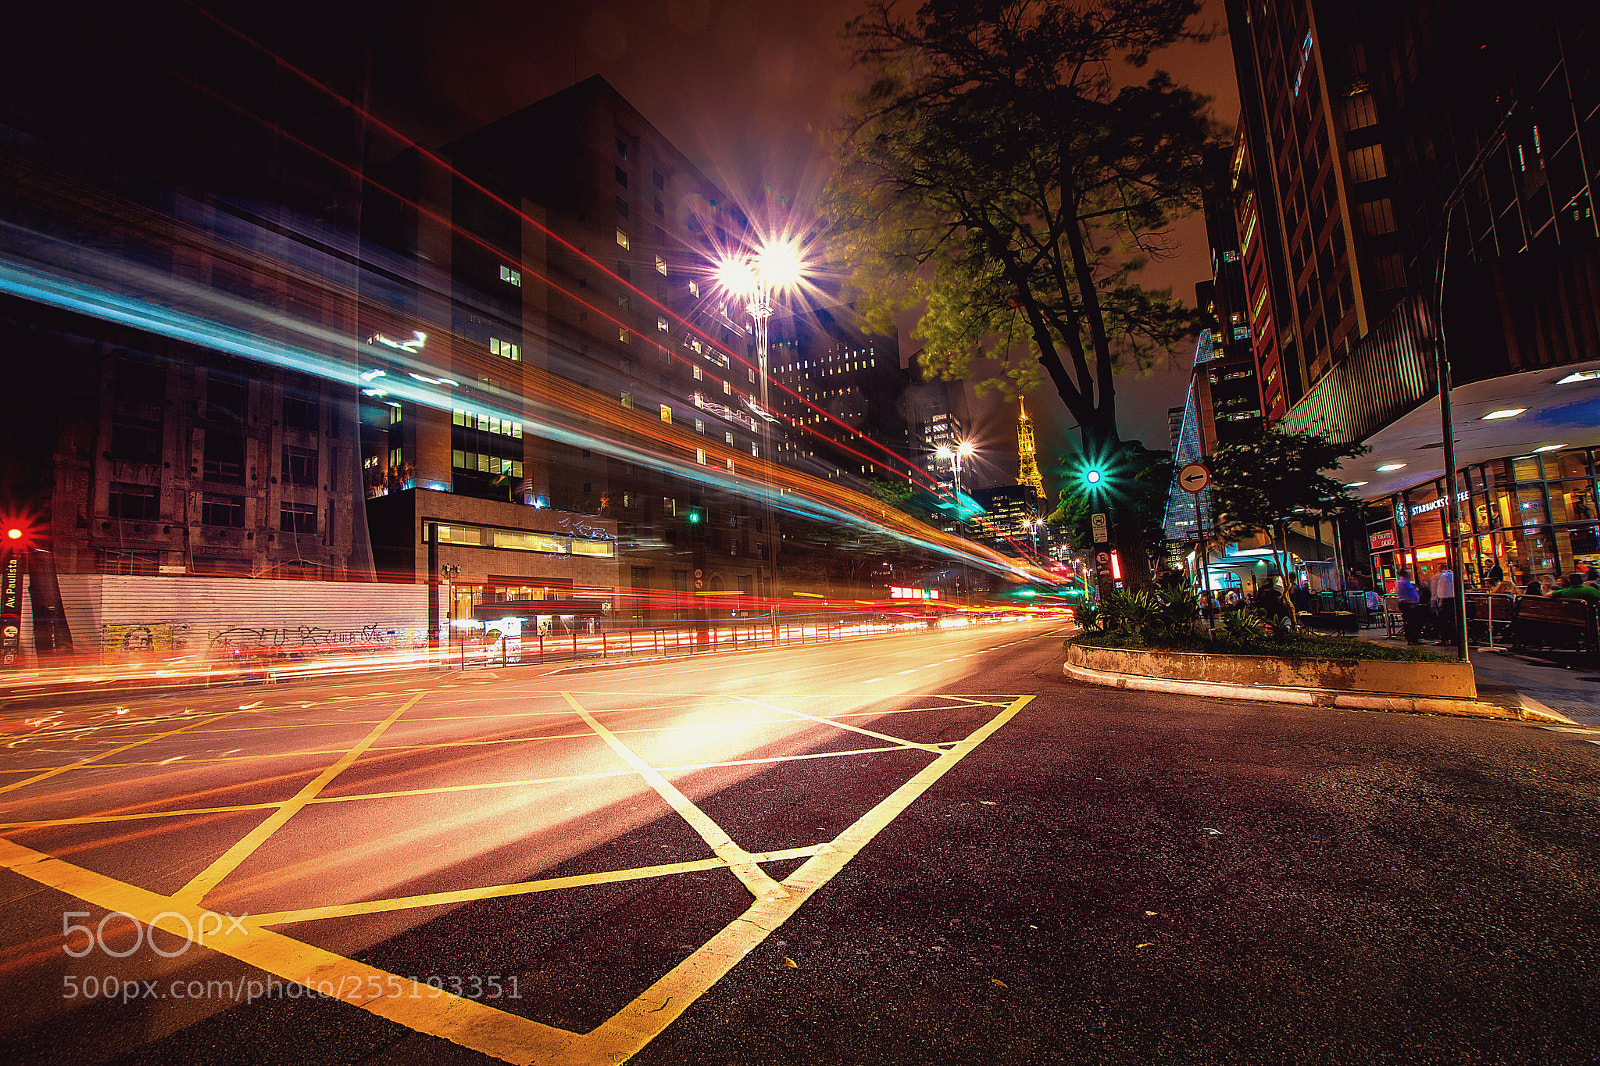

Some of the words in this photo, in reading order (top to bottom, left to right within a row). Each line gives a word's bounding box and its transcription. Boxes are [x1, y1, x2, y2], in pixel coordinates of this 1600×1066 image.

[1412, 498, 1445, 516] STARBUCKS
[1443, 490, 1470, 506] CFEE
[6, 559, 17, 594] Paulista
[5, 596, 15, 609] Av.
